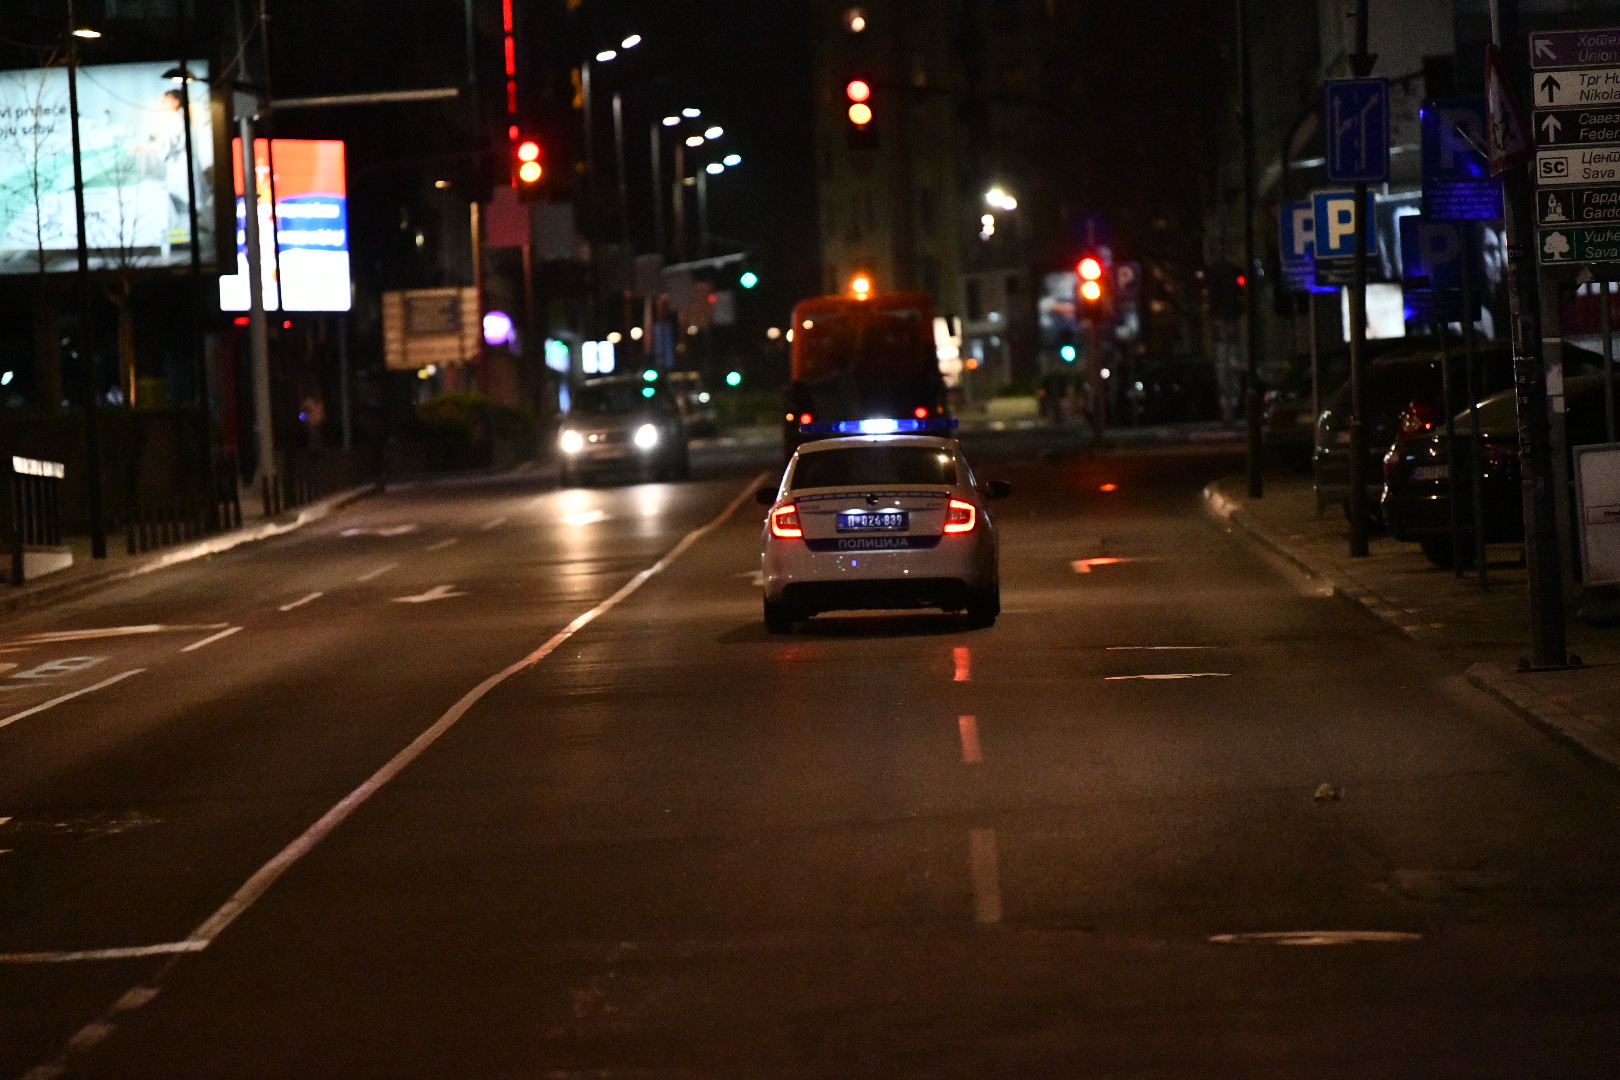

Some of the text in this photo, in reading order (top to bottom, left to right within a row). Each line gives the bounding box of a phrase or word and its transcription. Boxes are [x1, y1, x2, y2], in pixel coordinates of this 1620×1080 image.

[1579, 50, 1617, 63] Union
[1579, 74, 1602, 87] Трг
[1580, 88, 1620, 101] Nikola
[1579, 113, 1620, 125] Савез
[1542, 161, 1565, 174] SC
[1582, 167, 1615, 180] Sava
[1326, 199, 1358, 250] P
[1585, 246, 1618, 259] Sava
[838, 537, 909, 549] ПОЛИЦИЈА
